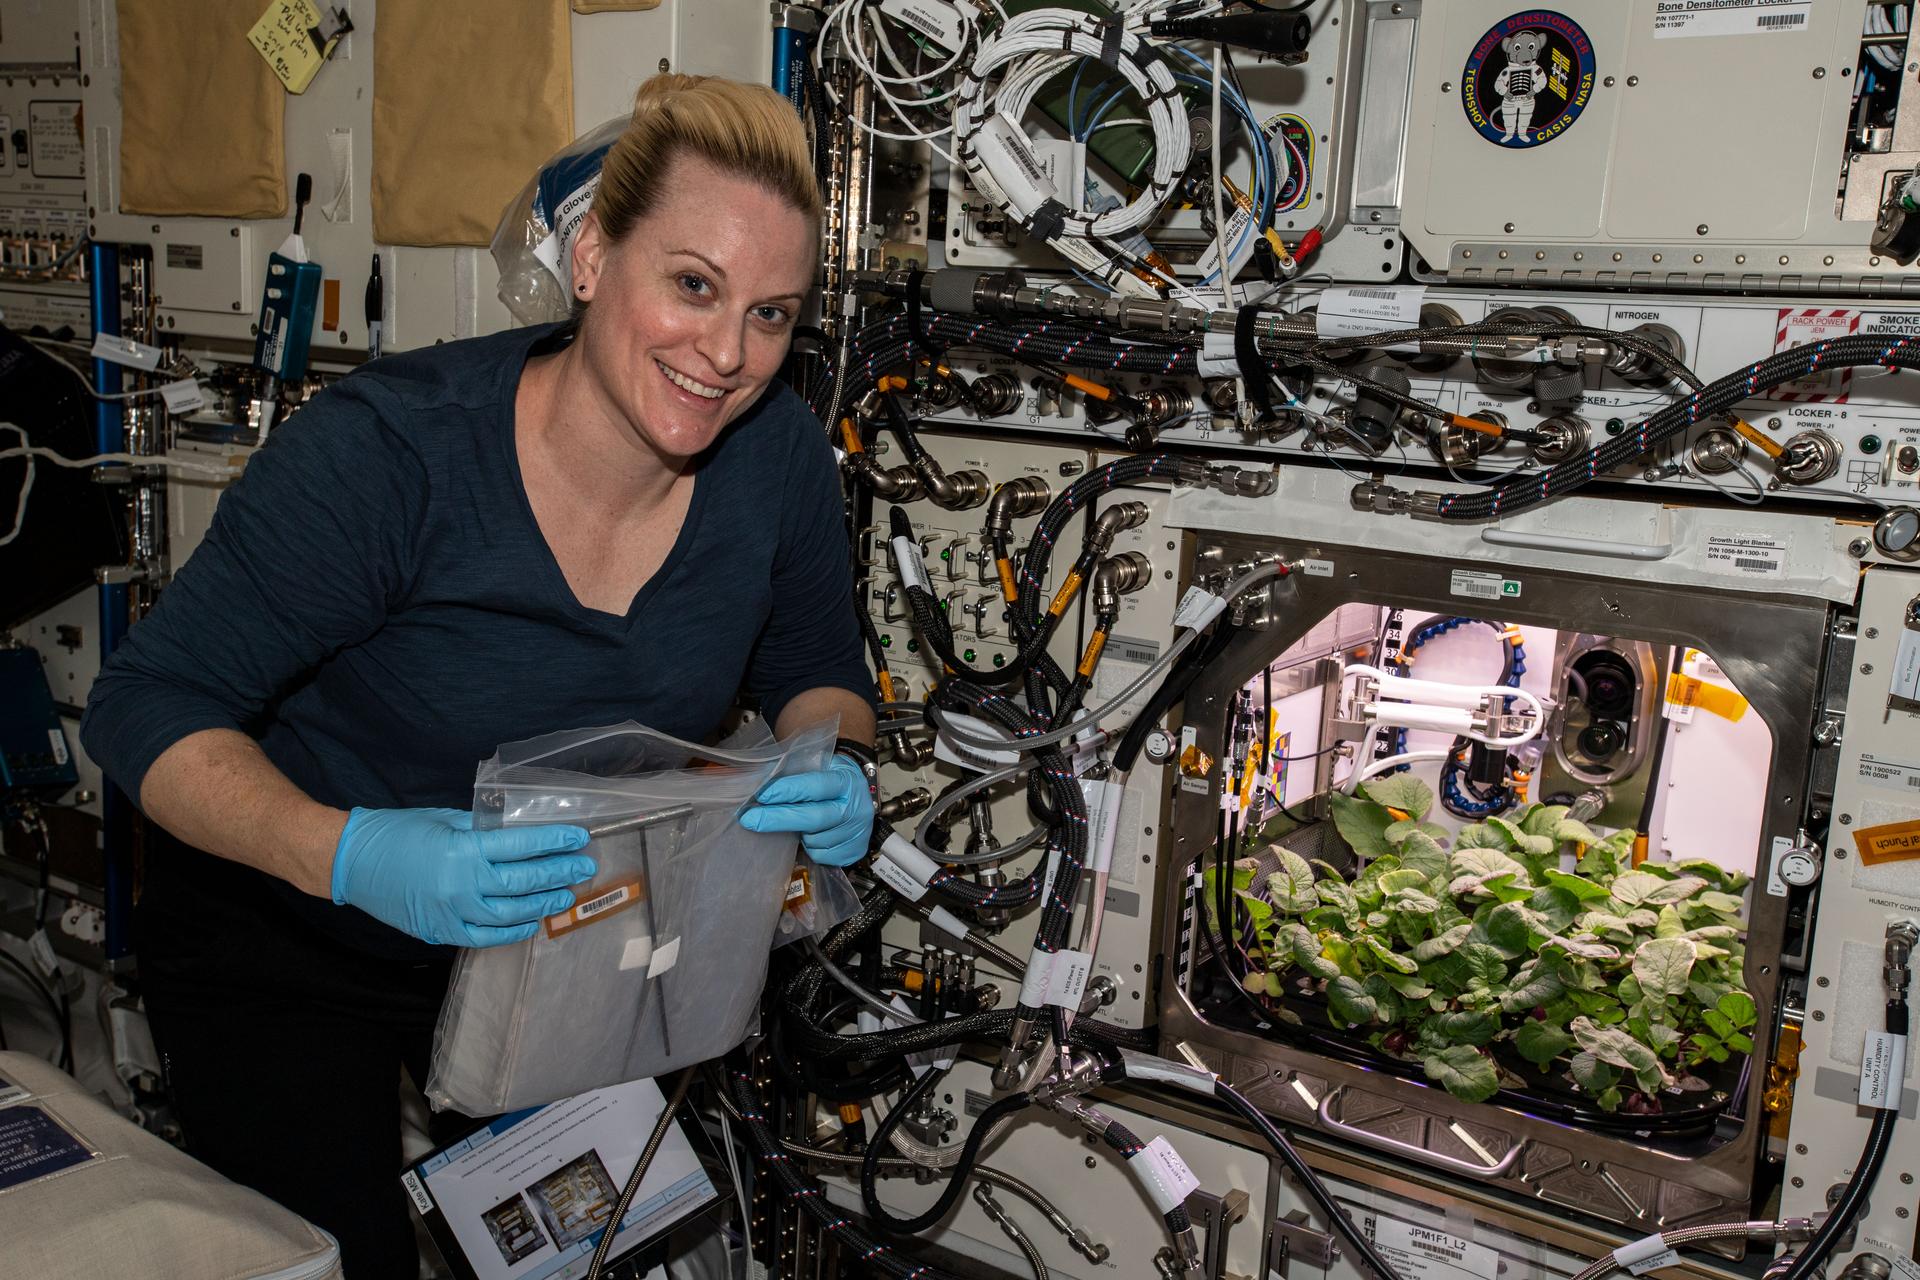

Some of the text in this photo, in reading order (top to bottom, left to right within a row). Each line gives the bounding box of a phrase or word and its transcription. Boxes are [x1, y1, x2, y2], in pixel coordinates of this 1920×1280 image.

[1657, 1, 1683, 11] Bone
[1686, 0, 1753, 10] Densitometer
[1506, 13, 1590, 55] DENSITOMETER
[1473, 30, 1501, 60] BONE
[1575, 73, 1593, 107] NASA
[1465, 69, 1487, 129] TECHSHOT
[1537, 114, 1572, 141] CASIS
[563, 191, 592, 215] Glove
[1614, 311, 1660, 321] NITROGEN
[1792, 317, 1847, 326] RACK POWER
[1879, 315, 1919, 325] SMOKE
[1810, 326, 1825, 334] JEM
[1788, 408, 1832, 418] LOCKER
[1840, 411, 1847, 419] 8
[1029, 416, 1041, 424] G1
[1200, 430, 1211, 440] J1
[1853, 484, 1868, 493] J2
[1709, 536, 1776, 547] Growth Light Blanket
[1388, 629, 1401, 640] 34
[1386, 648, 1399, 658] 32
[1376, 741, 1389, 751] 22
[1859, 769, 1872, 777] S/N
[1860, 763, 1902, 776] P/N 1900522
[1190, 782, 1208, 790] Sample
[1876, 837, 1910, 849] Punch
[1868, 897, 1899, 908] HUMIDITY
[1865, 1057, 1873, 1073] UNIT
[1870, 1038, 1883, 1100] HUMIDITY CONTROL
[2, 1147, 68, 1172] PREFERENCE
[9, 1148, 39, 1163] MENU
[405, 1172, 430, 1210] Kate MSL
[1408, 1227, 1467, 1251] JPM1F1_L2
[1863, 1236, 1888, 1249] OUTLET
